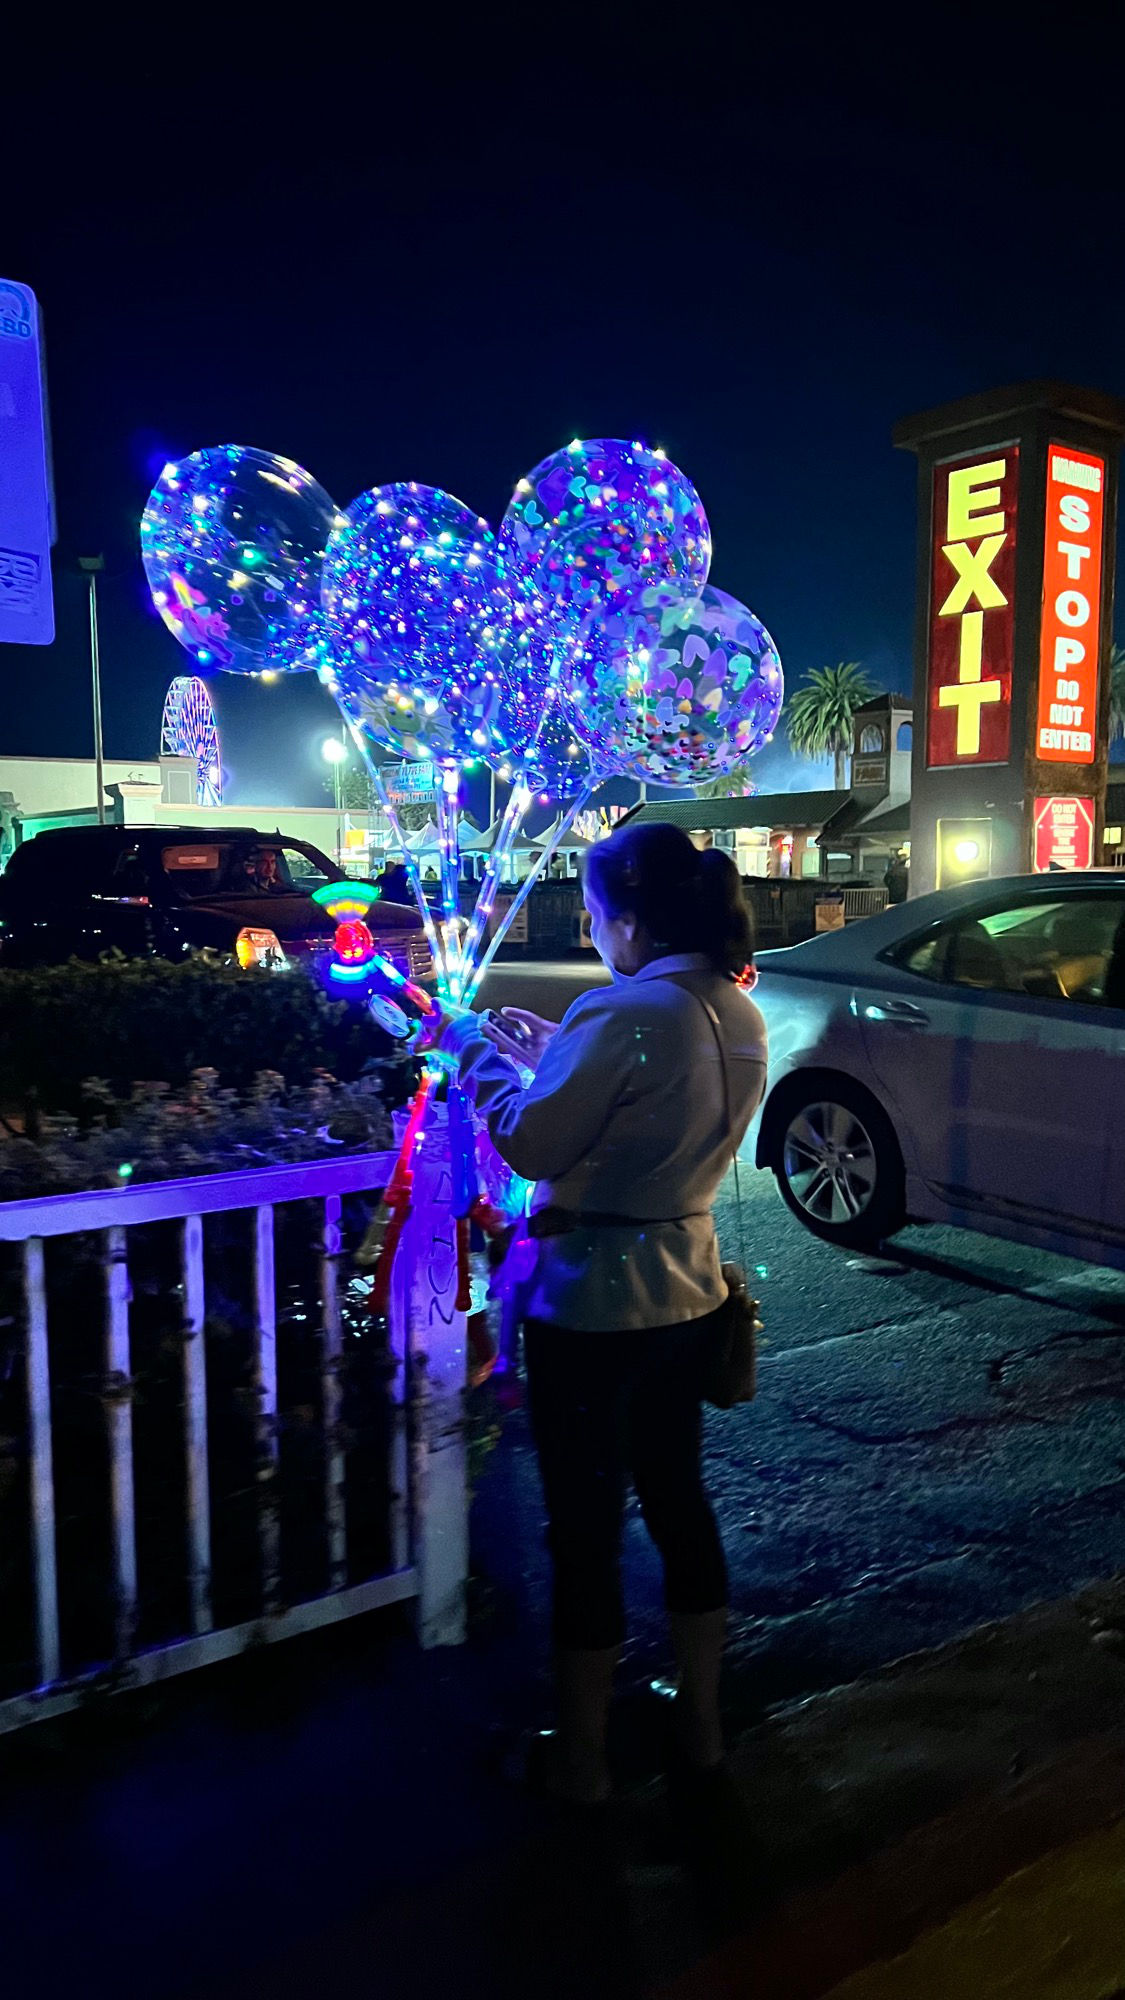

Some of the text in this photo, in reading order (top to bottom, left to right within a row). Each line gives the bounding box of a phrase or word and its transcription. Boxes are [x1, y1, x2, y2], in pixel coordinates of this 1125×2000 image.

[1054, 495, 1090, 672] STOP
[939, 459, 1008, 755] EXIT
[1056, 679, 1079, 701] DO
[1049, 704, 1084, 726] NOT
[1040, 728, 1091, 752] ENTER
